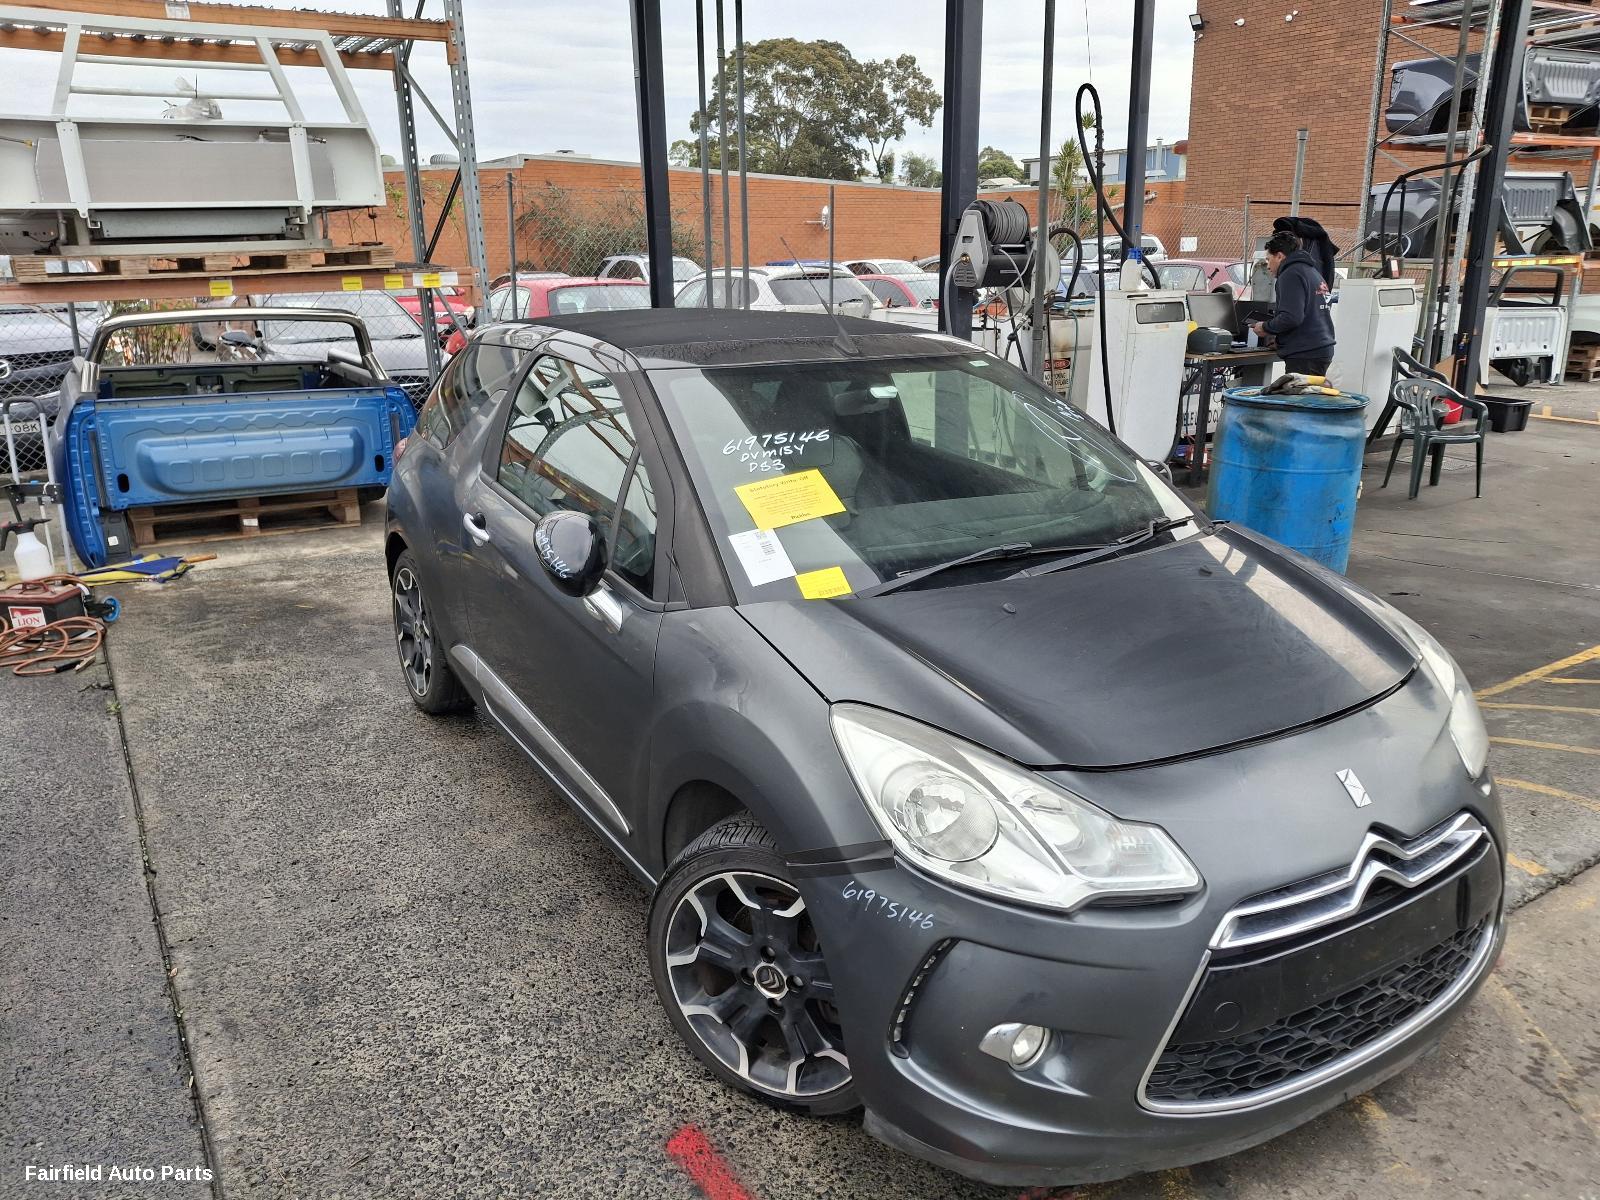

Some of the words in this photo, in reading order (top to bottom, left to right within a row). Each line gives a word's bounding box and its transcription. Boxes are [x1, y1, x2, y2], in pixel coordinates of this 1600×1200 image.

[722, 429, 830, 455] 61975146
[749, 458, 786, 473] DS3
[17, 617, 40, 627] LION
[842, 880, 934, 930] 61975146
